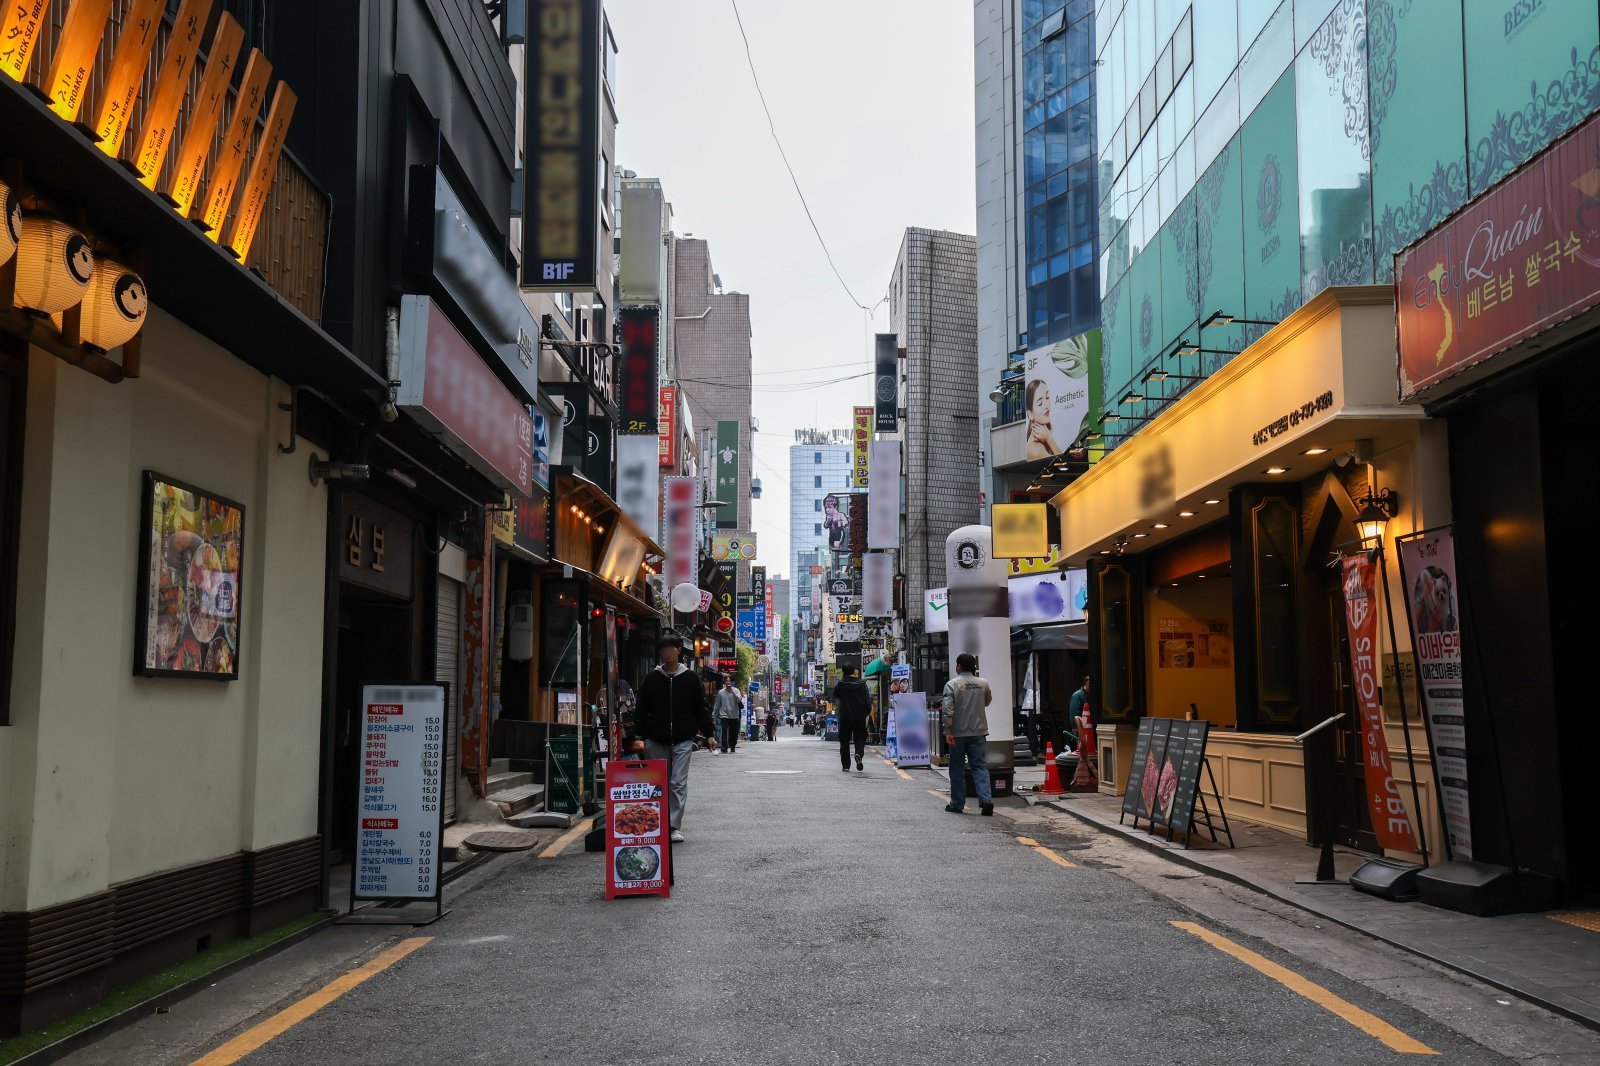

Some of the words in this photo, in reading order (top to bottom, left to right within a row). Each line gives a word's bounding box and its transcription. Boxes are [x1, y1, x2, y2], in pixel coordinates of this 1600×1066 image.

[14, 40, 29, 71] BLACK
[25, 20, 36, 39] SEA
[68, 67, 86, 109] CROAKER
[122, 86, 134, 118] MACKEREL
[148, 146, 161, 176] YELLOW
[157, 128, 166, 150] SQUID
[189, 168, 199, 192] URCHIN
[1464, 204, 1544, 281] Quán
[543, 262, 575, 279] B1F
[1467, 267, 1515, 320] 베트남
[1525, 231, 1582, 288] 쌀국수
[1027, 357, 1038, 371] 3F
[1055, 389, 1085, 405] Aesthetic
[629, 421, 647, 430] 2F
[754, 573, 763, 596] BAR
[371, 705, 399, 714] 메인메뉴
[612, 789, 650, 799] 쌈밥정식
[366, 820, 394, 828] 식사메뉴
[637, 837, 656, 845] 9,000
[643, 881, 662, 889] 9,000
